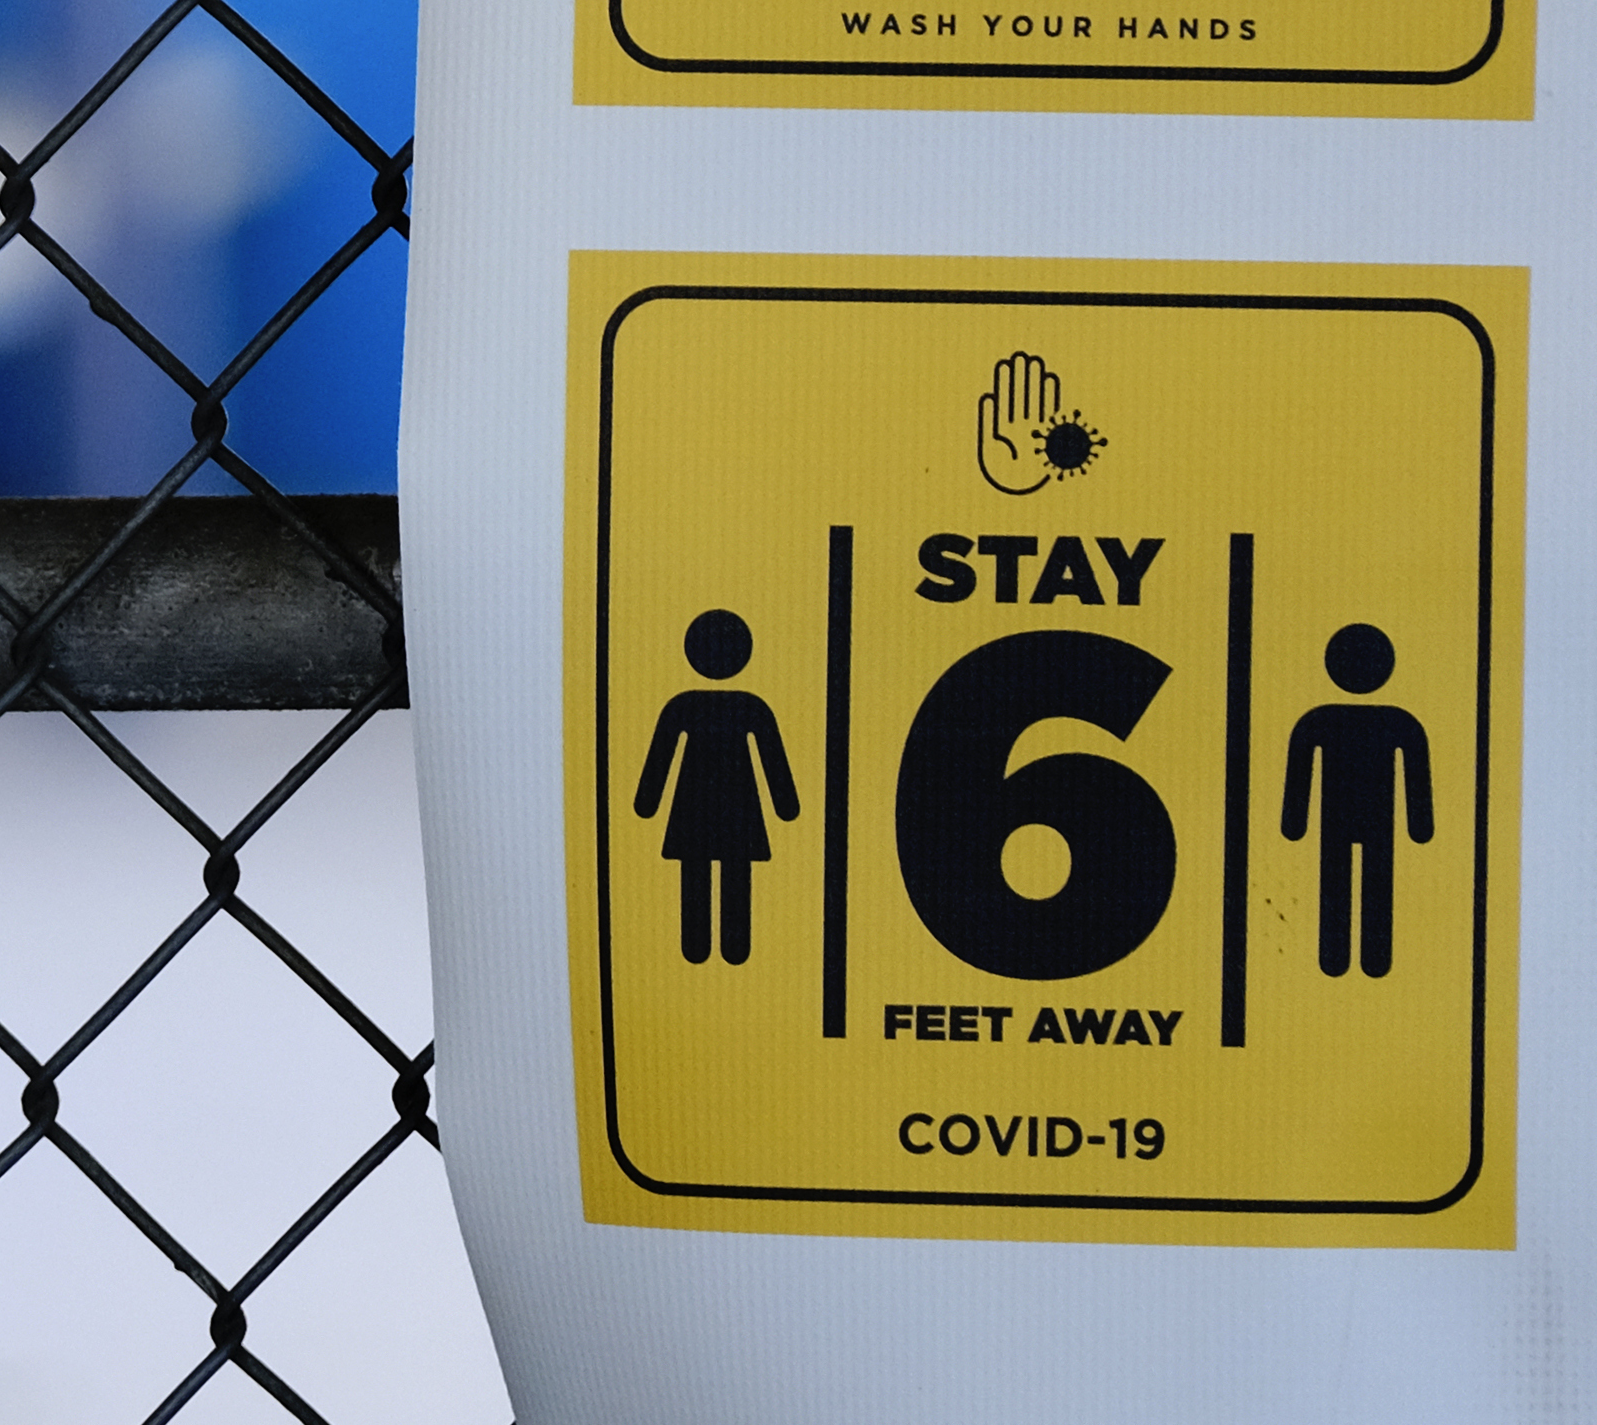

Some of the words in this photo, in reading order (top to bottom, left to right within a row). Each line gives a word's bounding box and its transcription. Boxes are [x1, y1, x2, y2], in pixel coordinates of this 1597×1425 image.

[841, 12, 957, 37] WASH
[983, 15, 1093, 39] YOUR
[1118, 17, 1257, 42] HANDS
[914, 533, 1166, 606] STAY
[894, 629, 1177, 981] 6
[883, 1004, 1013, 1043] FEET
[1027, 1007, 1184, 1046] AWAY
[898, 1112, 1166, 1161] COVID-19
